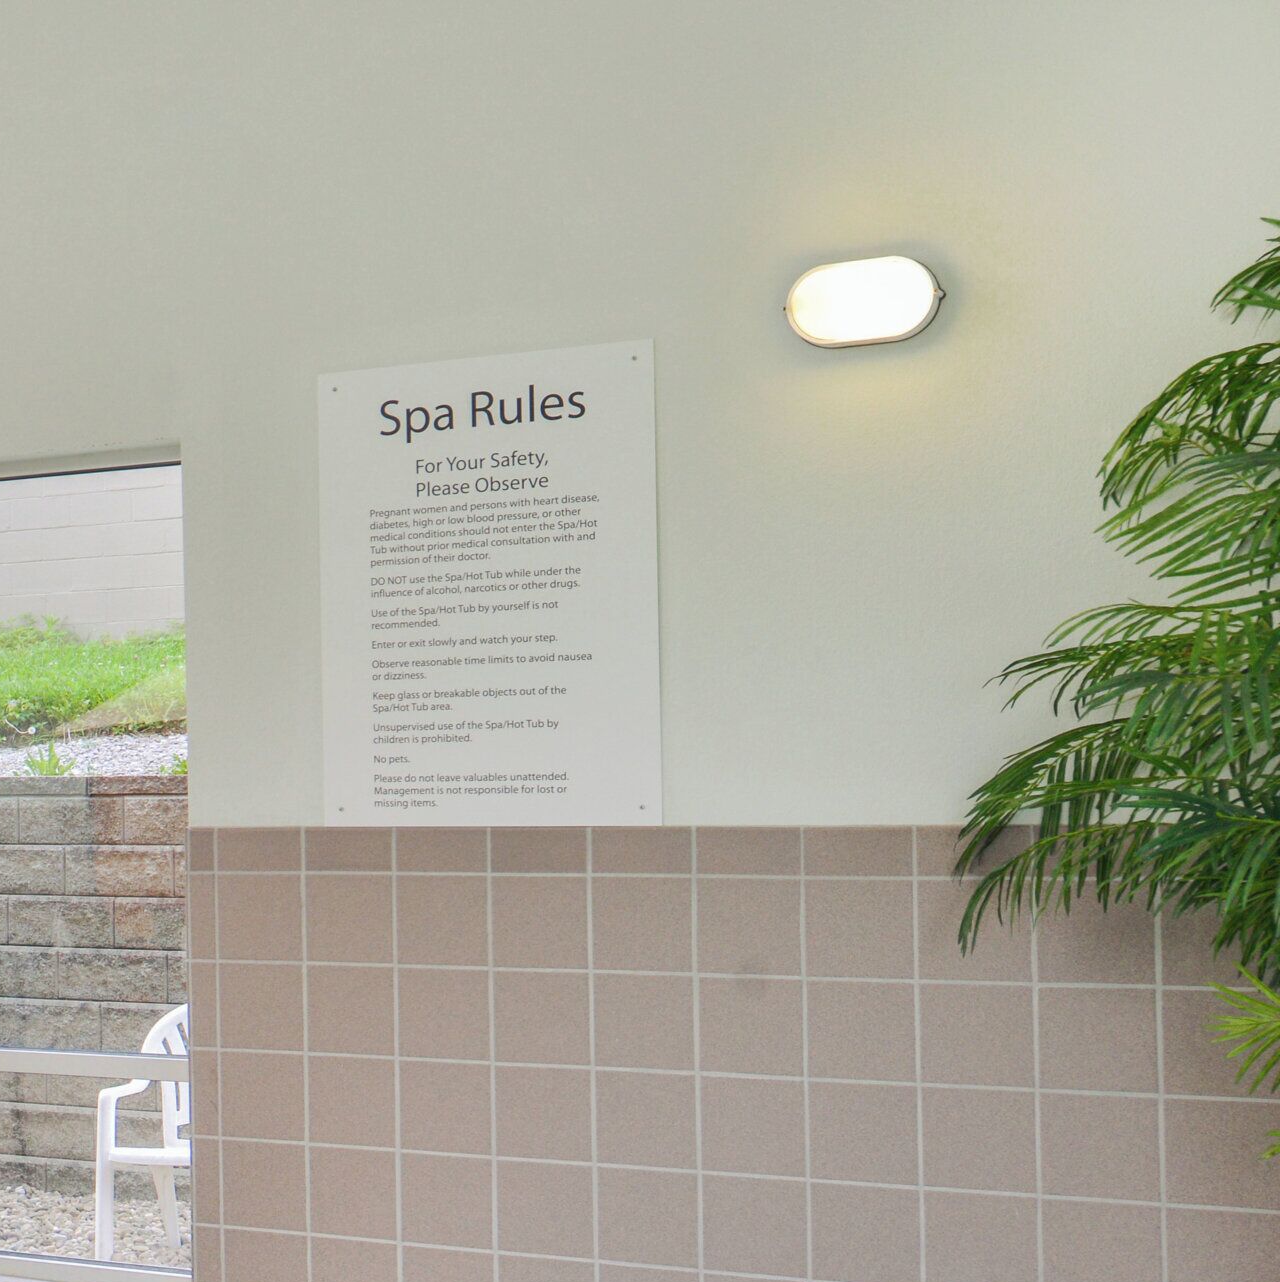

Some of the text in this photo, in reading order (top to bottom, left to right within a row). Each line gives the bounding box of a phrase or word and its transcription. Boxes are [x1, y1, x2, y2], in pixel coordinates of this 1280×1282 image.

[380, 385, 586, 443] Spa Rules
[416, 450, 549, 474] For Your Safety,
[416, 476, 549, 497] Please Observe
[370, 494, 600, 519] Pregnant women and persons with heart disease,
[370, 508, 581, 530] diabetes, high or low blood pressure, or other
[370, 519, 598, 542] medical conditions should not enter the Spa/Hot
[371, 531, 596, 554] Tub without prior medical consultation with and
[371, 552, 491, 568] permission of their doctor.
[371, 566, 581, 586] DO NOT use the Spa/Hot Tub while under the
[371, 580, 580, 598] influence of alcohol, narcotics or other drugs.
[371, 601, 559, 618] Use of the Spa/Hot Tub by yourself is not
[372, 618, 440, 630] recommended.
[372, 640, 396, 649] Enter
[409, 639, 426, 648] exit
[428, 637, 458, 647] slowly
[459, 636, 478, 646] and
[480, 635, 509, 644] watch
[511, 636, 533, 645] your
[535, 634, 558, 643] step.
[372, 660, 410, 669] Observe
[412, 657, 463, 667] reasonable
[465, 657, 486, 665] time
[488, 655, 514, 664] limits
[529, 653, 556, 663] avoid
[558, 653, 593, 661] nausea
[373, 685, 567, 702] Keep glass or breakable objects out of the
[373, 719, 559, 732] Unsupervised use of the Spa/Hot Tub by
[374, 755, 410, 765] No pets.
